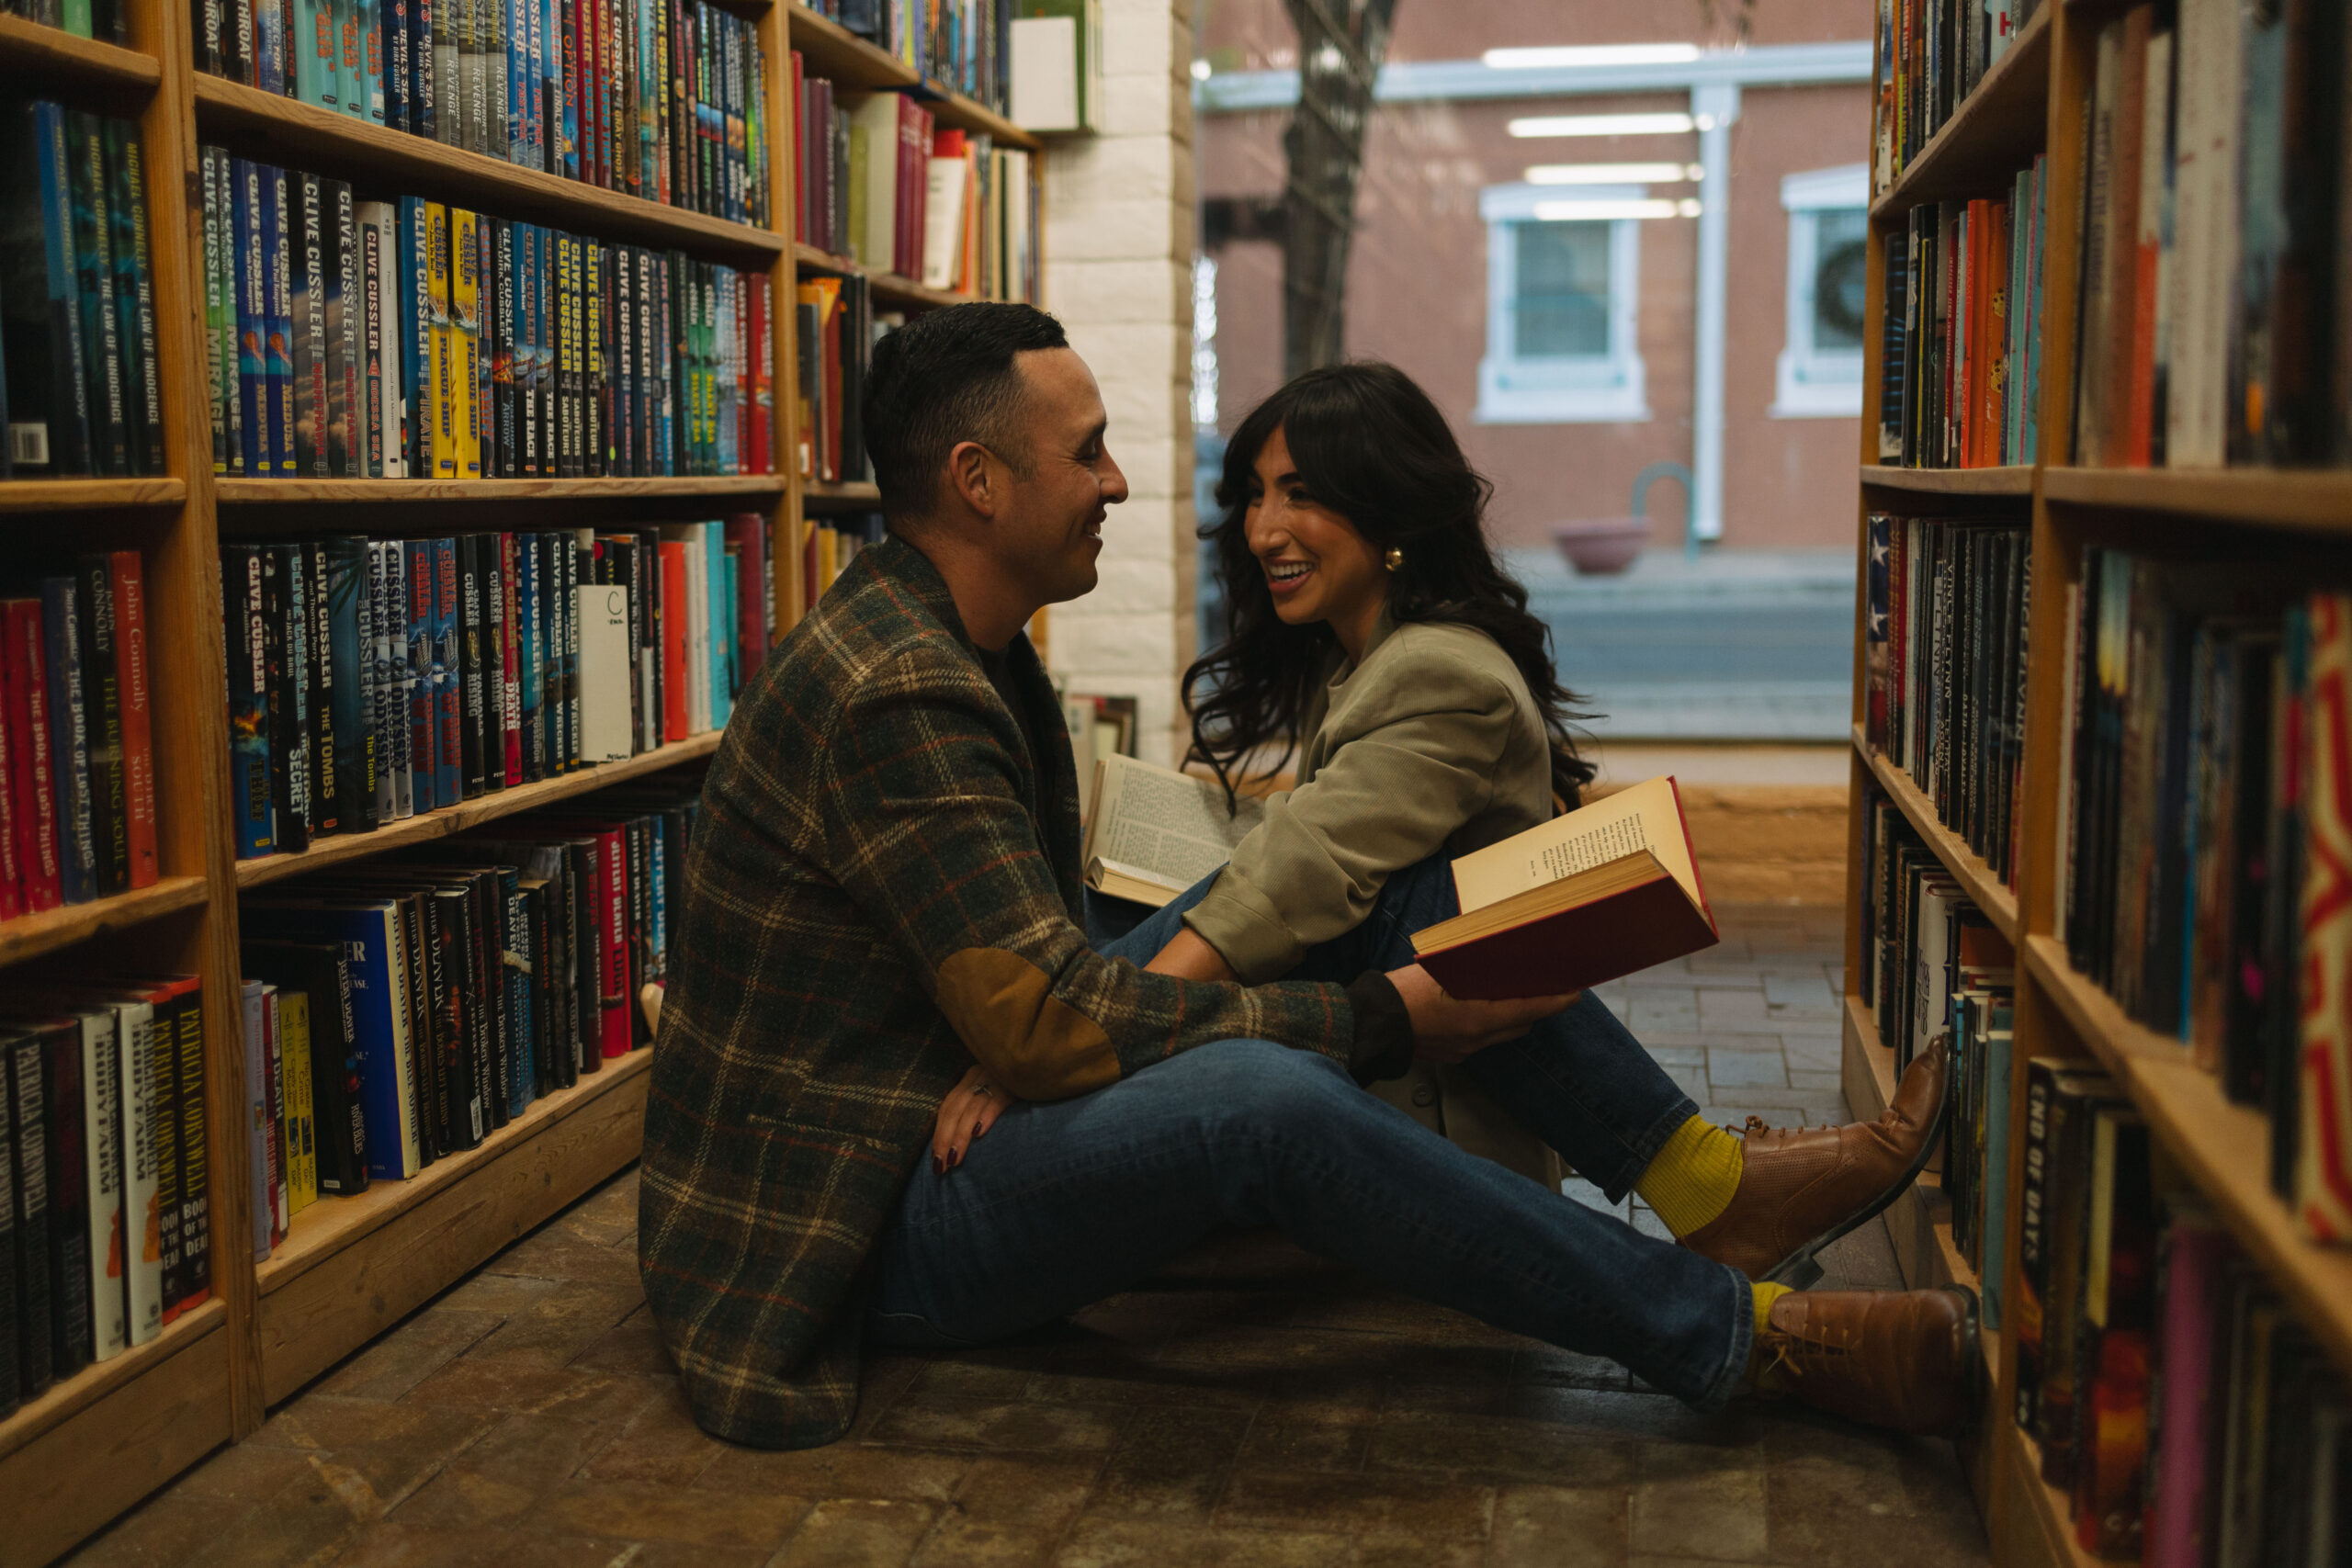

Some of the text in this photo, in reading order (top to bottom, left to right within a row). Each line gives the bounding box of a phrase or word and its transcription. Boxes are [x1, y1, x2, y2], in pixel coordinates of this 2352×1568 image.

[400, 28, 410, 104] DEVIL'S SEA
[424, 34, 435, 109] DEVIL'S SEA
[447, 60, 458, 118] REVENGE
[471, 67, 483, 124] REVENGE
[496, 65, 507, 122] REVENGE
[89, 135, 110, 275] MICHAEL CONNELLY
[126, 142, 148, 270] MICHAEL CONNELLY
[304, 182, 323, 341] CLIVE CUSSLER
[339, 190, 355, 343] CLIVE CUSSLER
[367, 231, 380, 351] CLIVE CUSSLER
[413, 207, 430, 355] CLIVE CUSSLER
[559, 238, 571, 371] CLIVE CUSSLER
[587, 243, 599, 373] CLIVE CUSSLER
[100, 276, 122, 425] THE LAW OF INNOCENCE
[138, 281, 159, 425] THE LAW OF INNOCENCE
[206, 327, 224, 434] MIRAGE
[227, 324, 243, 430] MIRAGE
[439, 337, 451, 438] PLAGUE SHIP
[467, 342, 478, 441] PLAGUE SHIP
[256, 382, 268, 454] MEDUSA
[282, 383, 294, 454] MEDUSA
[312, 363, 325, 457] NIGHTHAWK
[345, 367, 357, 457] NIGHTHAWK
[371, 379, 382, 462] ODESSA SEA
[420, 385, 433, 458] PIRATE
[503, 402, 511, 447] ARROW
[526, 389, 535, 458] THE RACE
[547, 422, 555, 459] RACE
[561, 396, 570, 457] SABOTEURS
[589, 395, 598, 456] SABOTEURS
[92, 569, 109, 653] CONNOLLY
[248, 557, 266, 694] CLIVE CUSSLER
[315, 552, 332, 689] CLIVE CUSSLER
[368, 548, 384, 638] CUSSLER
[386, 548, 401, 636] CUSSLER
[464, 572, 474, 626] CUSSLER
[489, 570, 499, 625] CUSSLER
[530, 542, 541, 673] CLIVE CUSSLER
[553, 541, 563, 658] CLIVE CUSSLER
[569, 539, 578, 655] CLIVE CUSSLER
[608, 592, 623, 615] C
[122, 574, 147, 714] John Connolly
[287, 643, 294, 654] DU
[287, 657, 295, 679] BRUL
[357, 610, 375, 698] CUSSLER
[391, 686, 407, 773] ODYSSEY
[467, 673, 478, 717] RISING
[491, 670, 501, 713] RISING
[504, 682, 517, 731] DEATH
[555, 700, 563, 760] WRECKER
[571, 697, 579, 754] WRECKER
[2015, 651, 2029, 741] FLYNN
[103, 674, 127, 864] THE BURNING SOUL
[321, 705, 335, 799] THE TOMBS
[367, 735, 376, 793] The Tombs
[374, 690, 390, 779] ODYSSEY
[131, 754, 145, 821] SOUTH
[288, 749, 304, 816] SECRET
[508, 897, 517, 952] DEAVER
[653, 838, 666, 976] JEFFERY DEAVER
[338, 960, 355, 1043] JEFFERY DEAVER
[398, 974, 408, 1029] DEAVER
[413, 947, 424, 1021] DEAVER
[431, 937, 445, 1011] DEAVER
[153, 1020, 173, 1104] PATRICIA
[478, 1023, 490, 1063] Broken
[495, 995, 511, 1100] THE Broken Window
[179, 1008, 208, 1197] PATRICIA CORNWELL
[273, 1061, 284, 1120] DEATH
[350, 1103, 363, 1130] RIVER
[480, 1064, 492, 1110] Window
[2023, 1085, 2047, 1266] END OF DAYS
